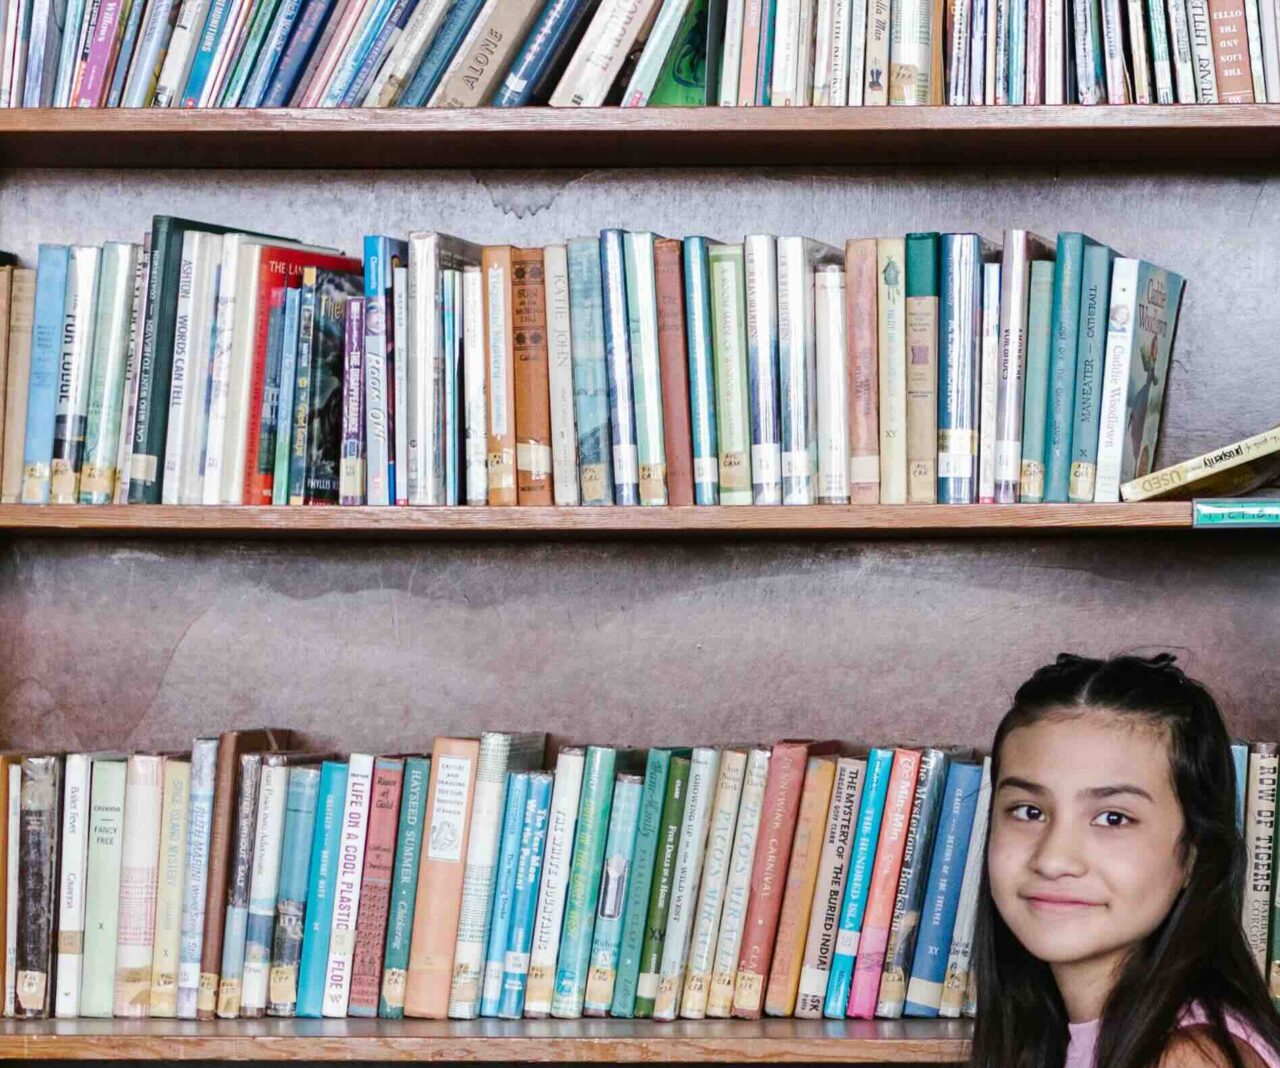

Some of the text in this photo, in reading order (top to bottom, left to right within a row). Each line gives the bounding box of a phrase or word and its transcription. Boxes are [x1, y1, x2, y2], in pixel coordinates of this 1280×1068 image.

[874, 19, 884, 41] Man
[1219, 25, 1238, 33] THE
[464, 28, 503, 90] ALONE
[1194, 55, 1214, 104] STUART
[1224, 67, 1243, 77] THE
[269, 261, 288, 274] THE
[369, 256, 377, 290] Clements
[171, 260, 193, 407] ASHTON WORDS CAN TELL
[553, 274, 568, 368] KATIE JOHN
[1081, 284, 1098, 422] MANEATER CATHERALL
[136, 319, 154, 443] CAT WHO WENT TO HEAVEN
[1105, 346, 1125, 448] Caddie Woodlawn
[1142, 469, 1182, 492] USED
[1203, 445, 1243, 469] prosperity
[172, 780, 182, 804] SPICE
[351, 782, 364, 808] LIFE
[641, 761, 663, 838] Jane-Emily
[686, 774, 702, 822] GROWING
[888, 780, 909, 841] Min-Min
[348, 812, 361, 828] ON
[517, 799, 537, 890] Won the Pennant
[529, 809, 546, 884] The Year Mom
[686, 824, 694, 838] UP
[828, 824, 838, 845] CLARK
[890, 754, 934, 932] The Mysterious Buckskin
[1253, 766, 1277, 893] ROW OF TIGERS
[65, 786, 79, 909] Ballet Cavanna
[190, 806, 206, 911] RUTH MARINI World
[238, 818, 251, 887] WITHOUT SALT
[342, 845, 357, 877] COOL
[392, 770, 422, 950] HAYSEED SUMMER Chickering
[823, 770, 859, 931] THE MYSTERY THE BURIED
[850, 838, 868, 899] HUNDRED
[336, 881, 353, 930] PLASTIC
[539, 810, 568, 951] THE WHITE MOUNTAINS
[675, 866, 689, 893] WILD
[673, 896, 684, 922] WEST
[1258, 899, 1270, 953] BARBARA
[330, 960, 345, 989] FLOE
